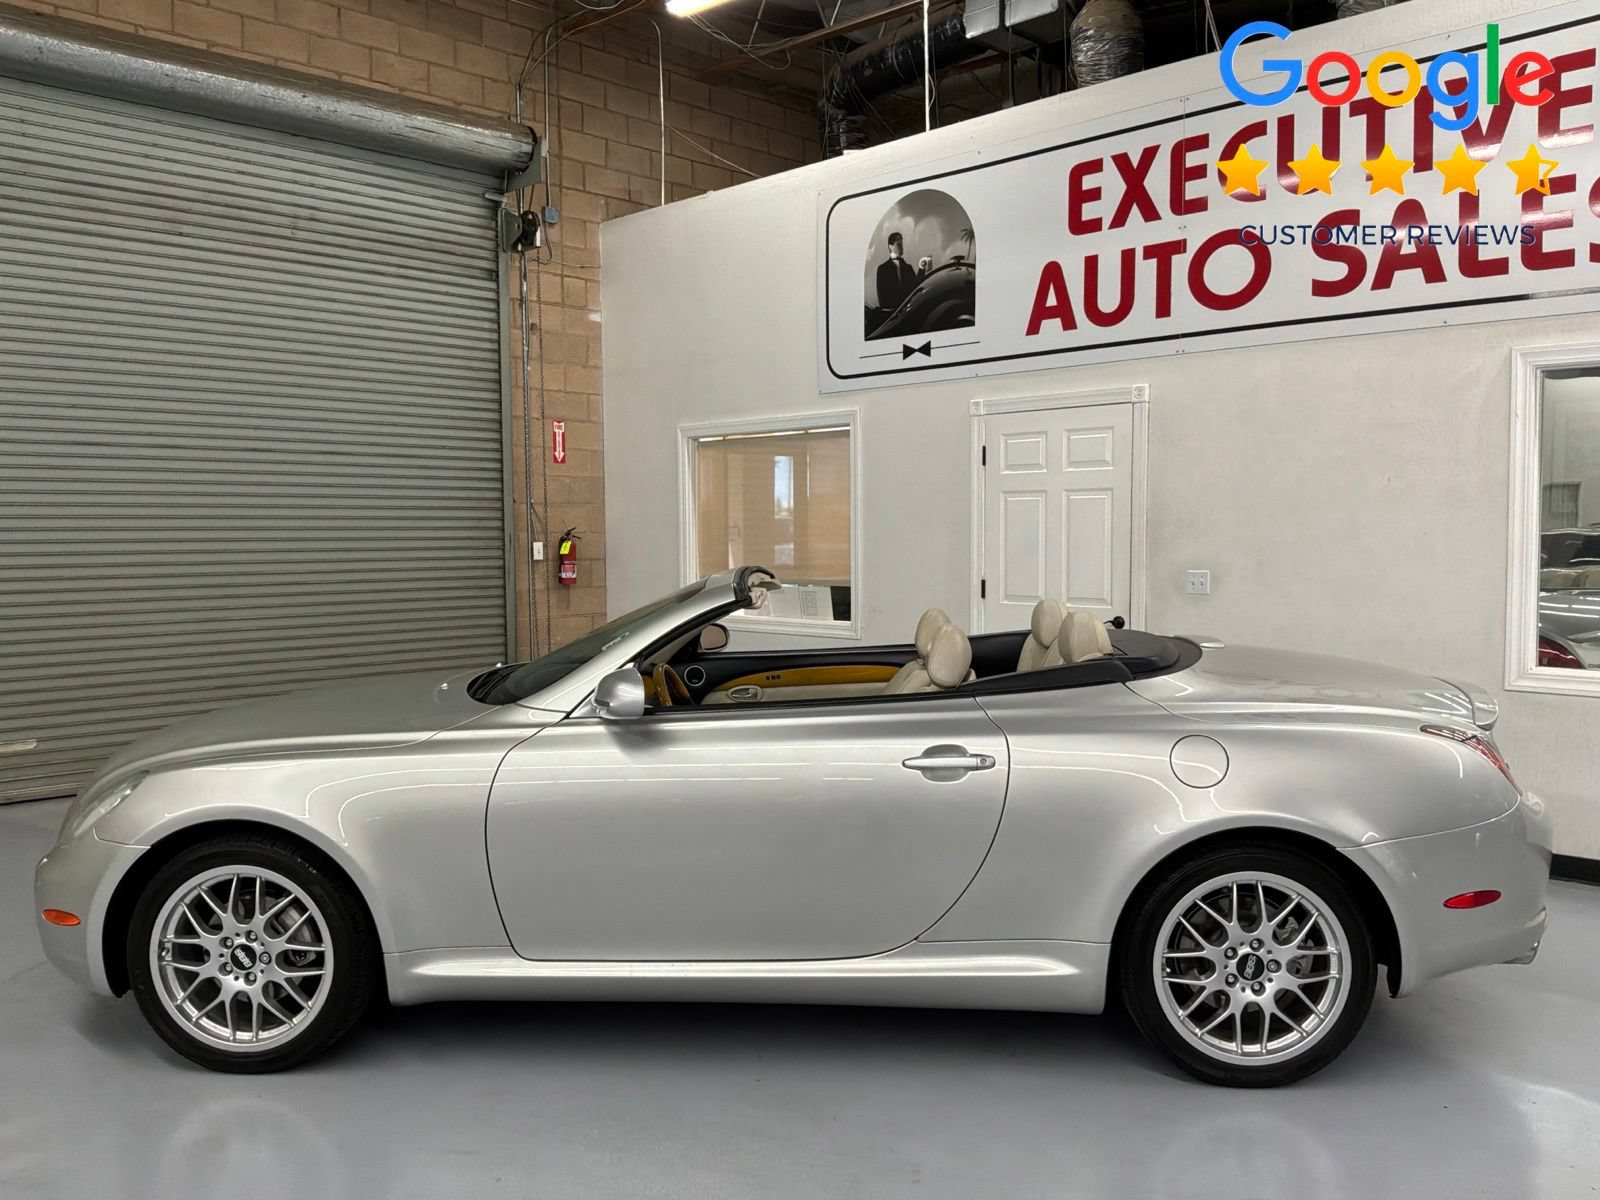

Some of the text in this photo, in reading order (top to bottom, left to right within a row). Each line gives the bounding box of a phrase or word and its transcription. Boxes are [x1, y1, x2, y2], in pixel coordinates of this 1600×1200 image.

[1025, 174, 1600, 336] AUTO SALE
[235, 947, 252, 967] BBS
[1244, 955, 1256, 979] BBS
